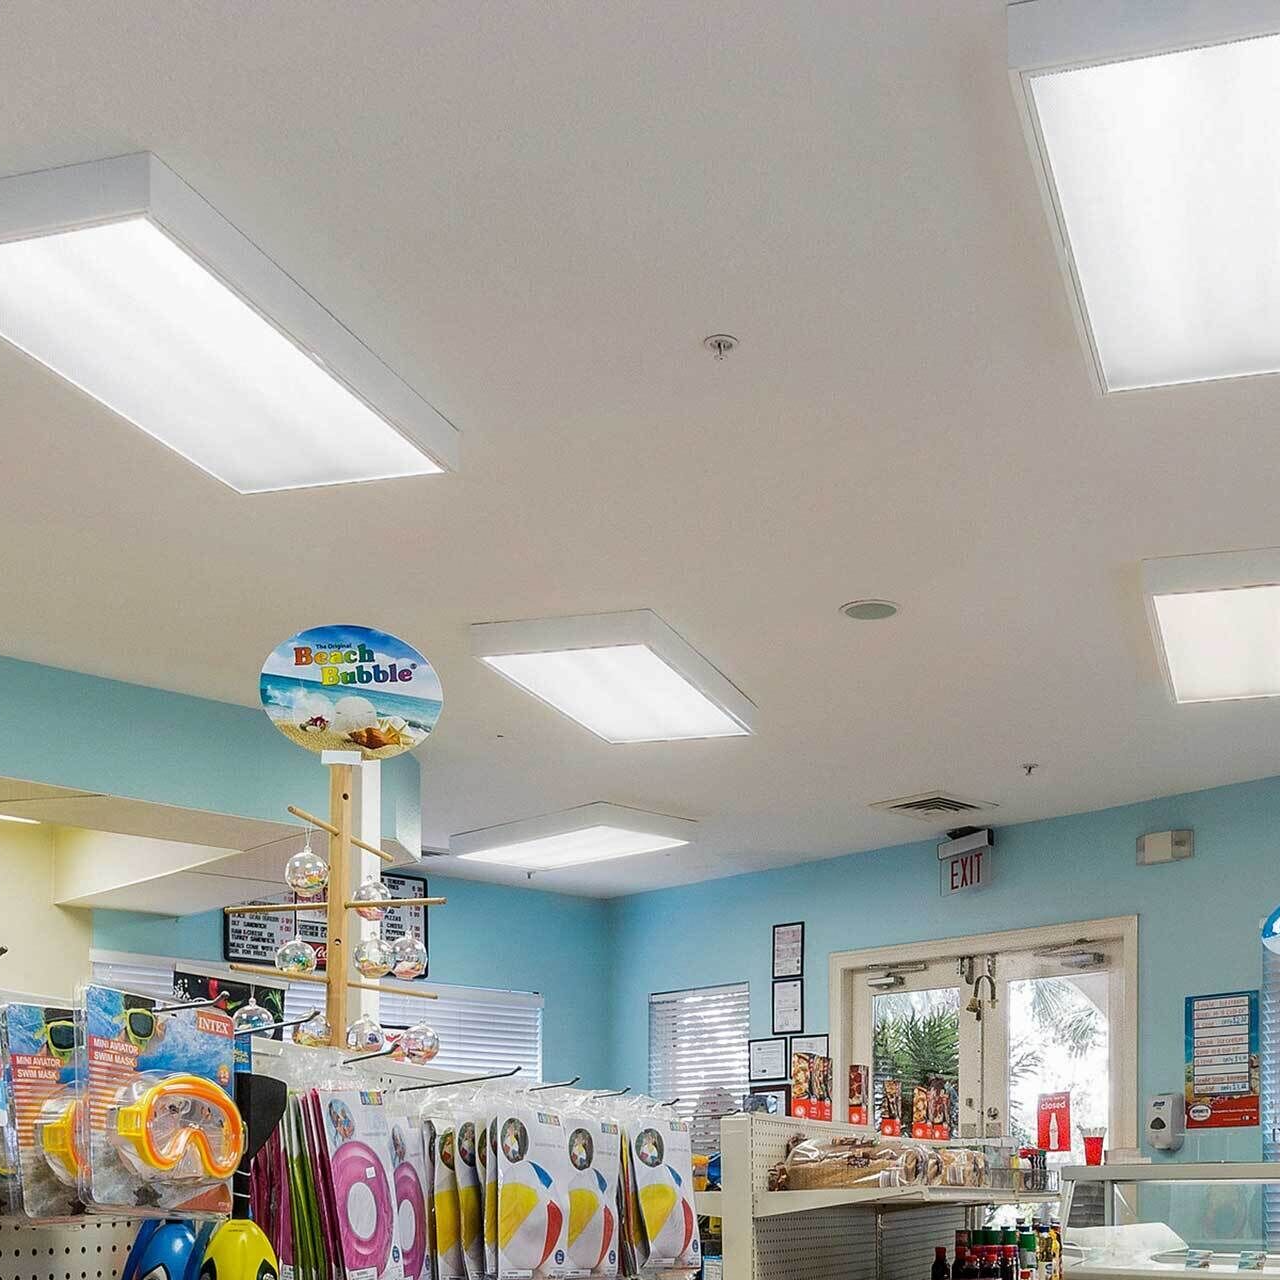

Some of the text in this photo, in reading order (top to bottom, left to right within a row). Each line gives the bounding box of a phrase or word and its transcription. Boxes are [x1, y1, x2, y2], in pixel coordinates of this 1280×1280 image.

[294, 644, 375, 666] Beach
[321, 663, 413, 686] Bubble
[951, 852, 983, 890] EXIT
[197, 1016, 231, 1034] INTEX
[93, 1038, 139, 1056] MINI AVIATOR
[16, 1056, 61, 1067] MINI AVIATOR
[93, 1051, 136, 1066] SWIM MASK
[17, 1069, 58, 1080] SWIM MASK
[1040, 1100, 1067, 1110] closed
